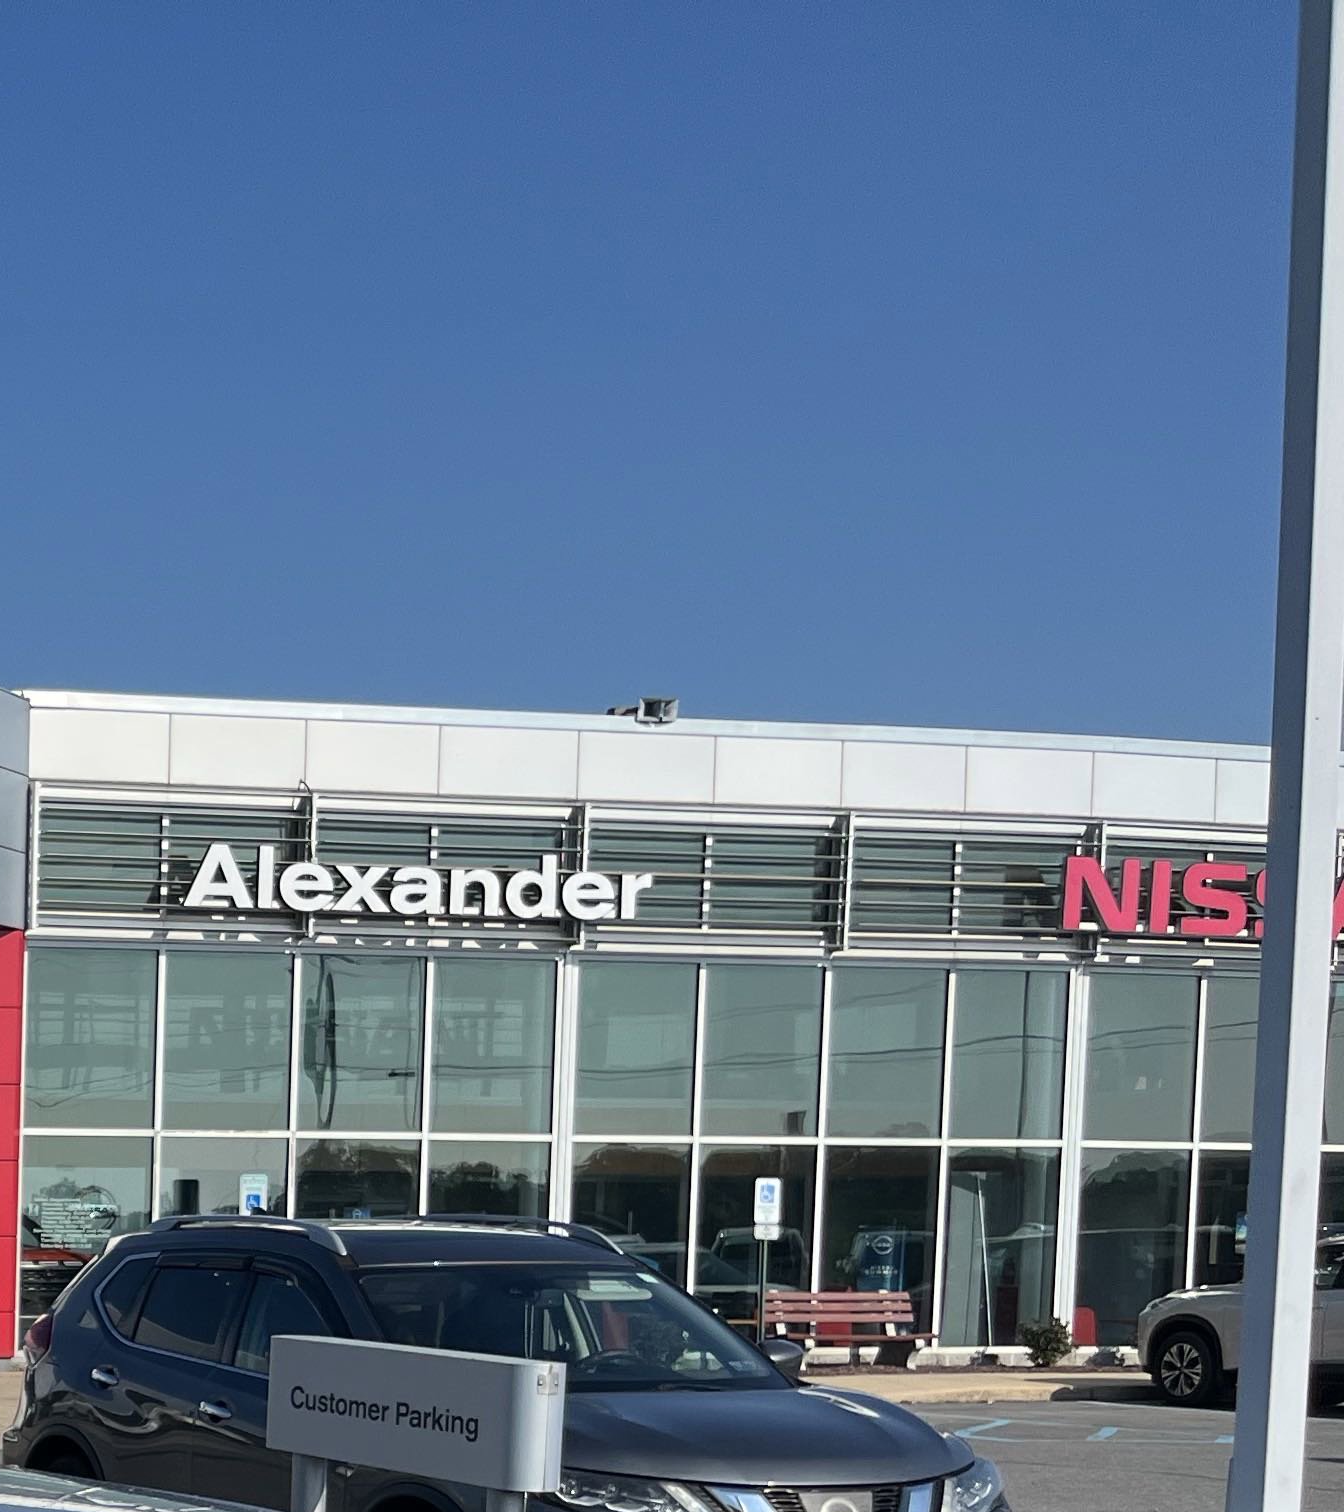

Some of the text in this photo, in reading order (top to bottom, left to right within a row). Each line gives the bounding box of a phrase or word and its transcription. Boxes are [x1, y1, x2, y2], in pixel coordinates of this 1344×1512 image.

[183, 843, 653, 920] Alexander
[290, 1386, 480, 1443] Customer Parking
